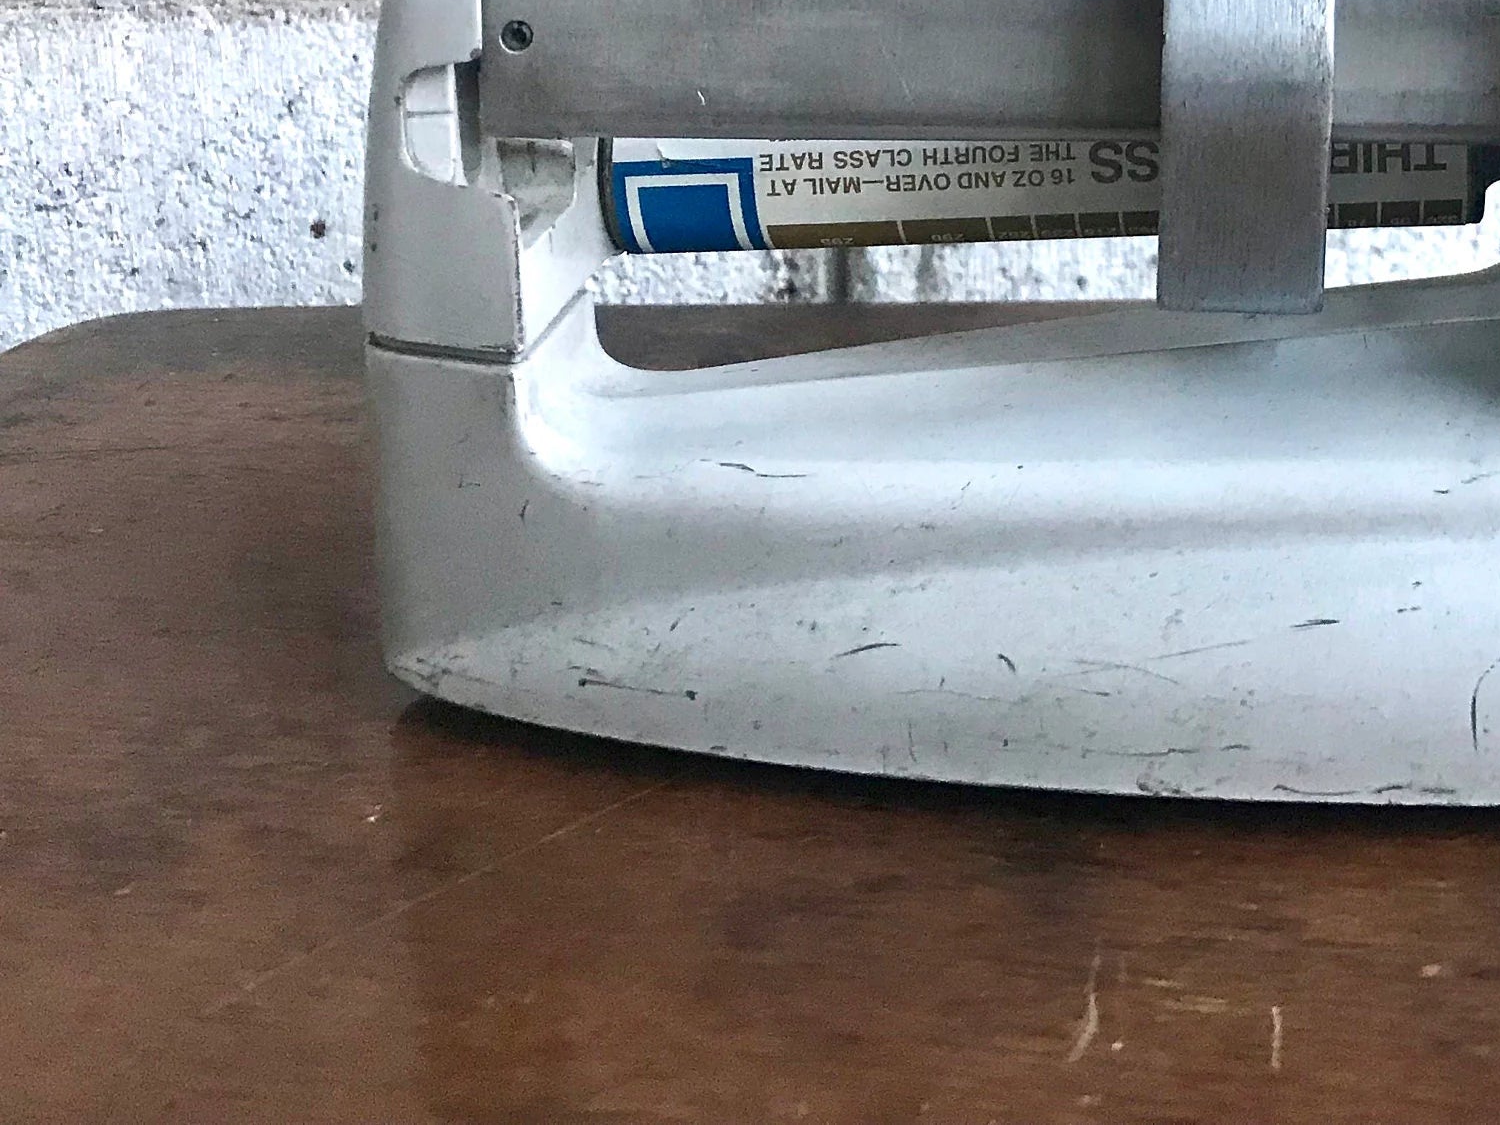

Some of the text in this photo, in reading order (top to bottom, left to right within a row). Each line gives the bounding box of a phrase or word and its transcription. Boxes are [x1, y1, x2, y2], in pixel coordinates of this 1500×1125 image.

[759, 142, 1077, 172] THE FOURTH CLASS RATE
[957, 170, 1006, 190] AND
[1012, 169, 1045, 187] OZ
[1050, 168, 1077, 186] 16
[766, 179, 797, 196] AT
